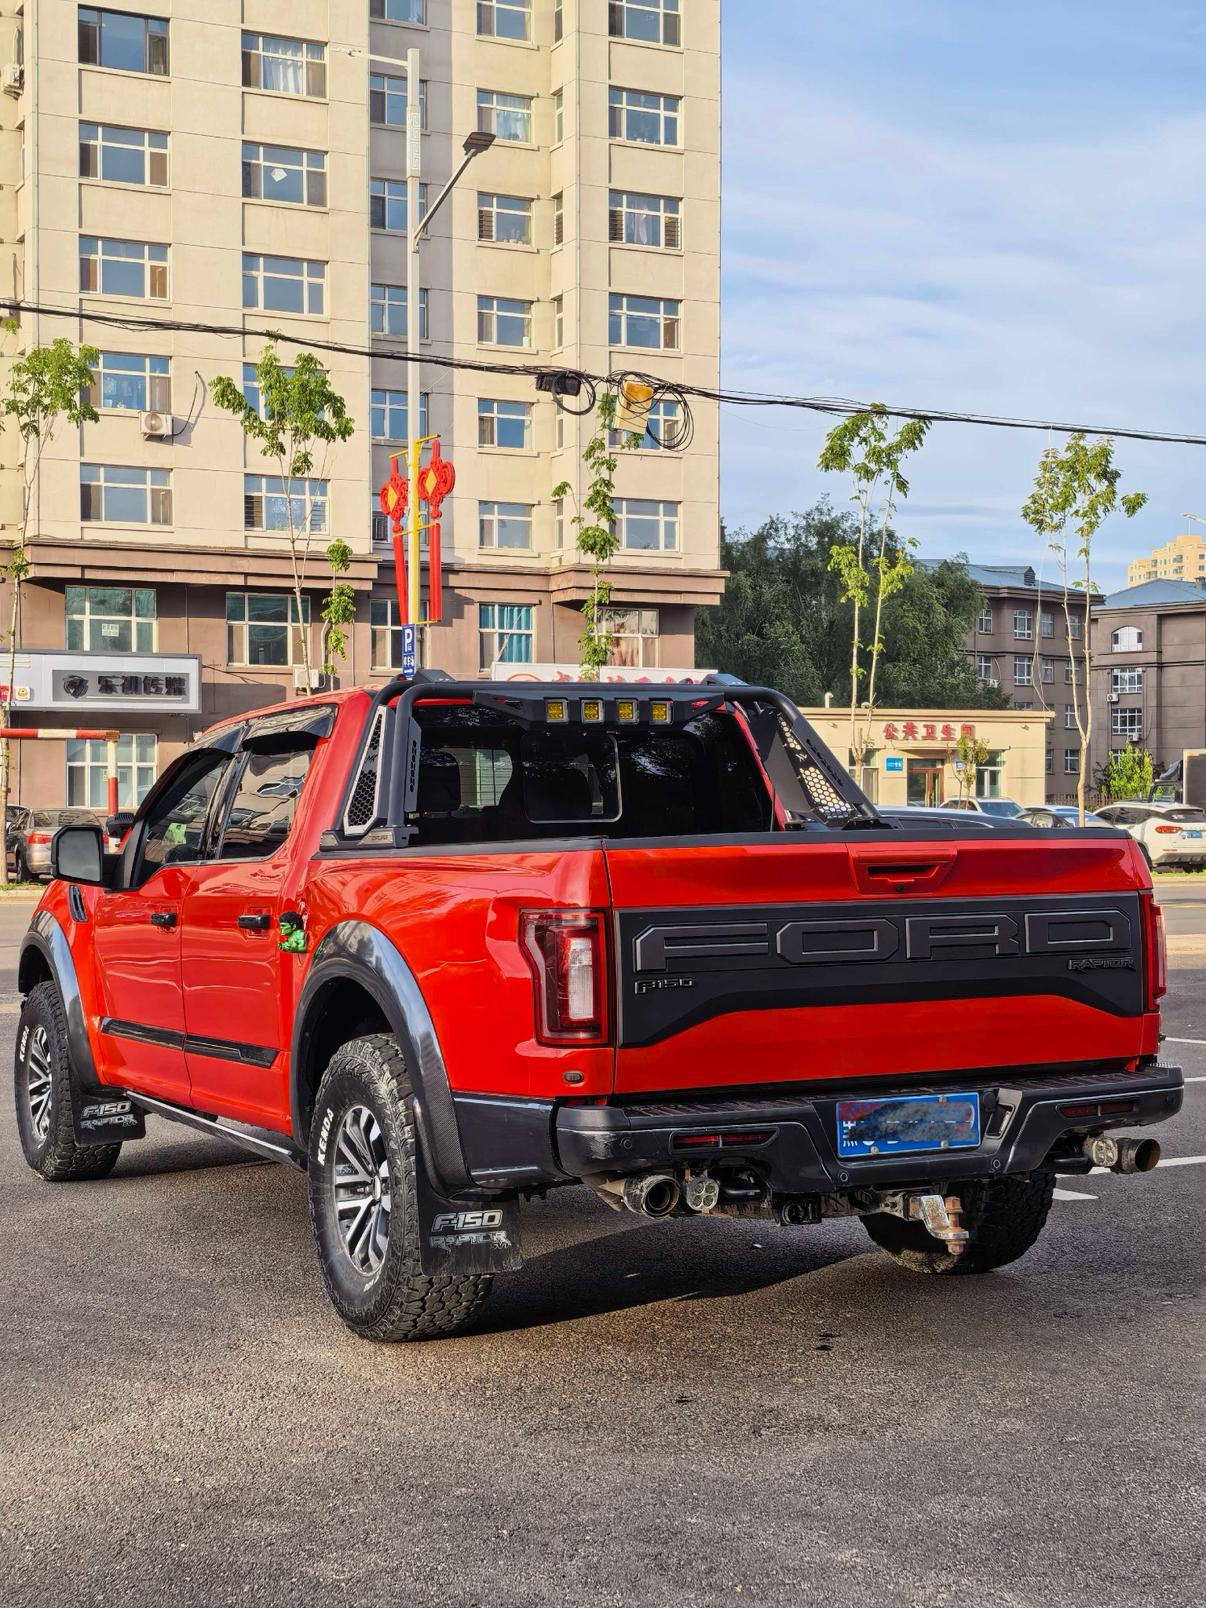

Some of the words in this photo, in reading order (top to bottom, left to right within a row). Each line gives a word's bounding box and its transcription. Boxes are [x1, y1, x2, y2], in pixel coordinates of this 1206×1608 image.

[404, 628, 412, 652] P
[882, 721, 975, 741] 公共卫生间
[633, 909, 1132, 973] FORD
[1068, 958, 1136, 974] RAPTOR
[19, 1025, 30, 1062] KENDA
[317, 1107, 334, 1166] KENDA
